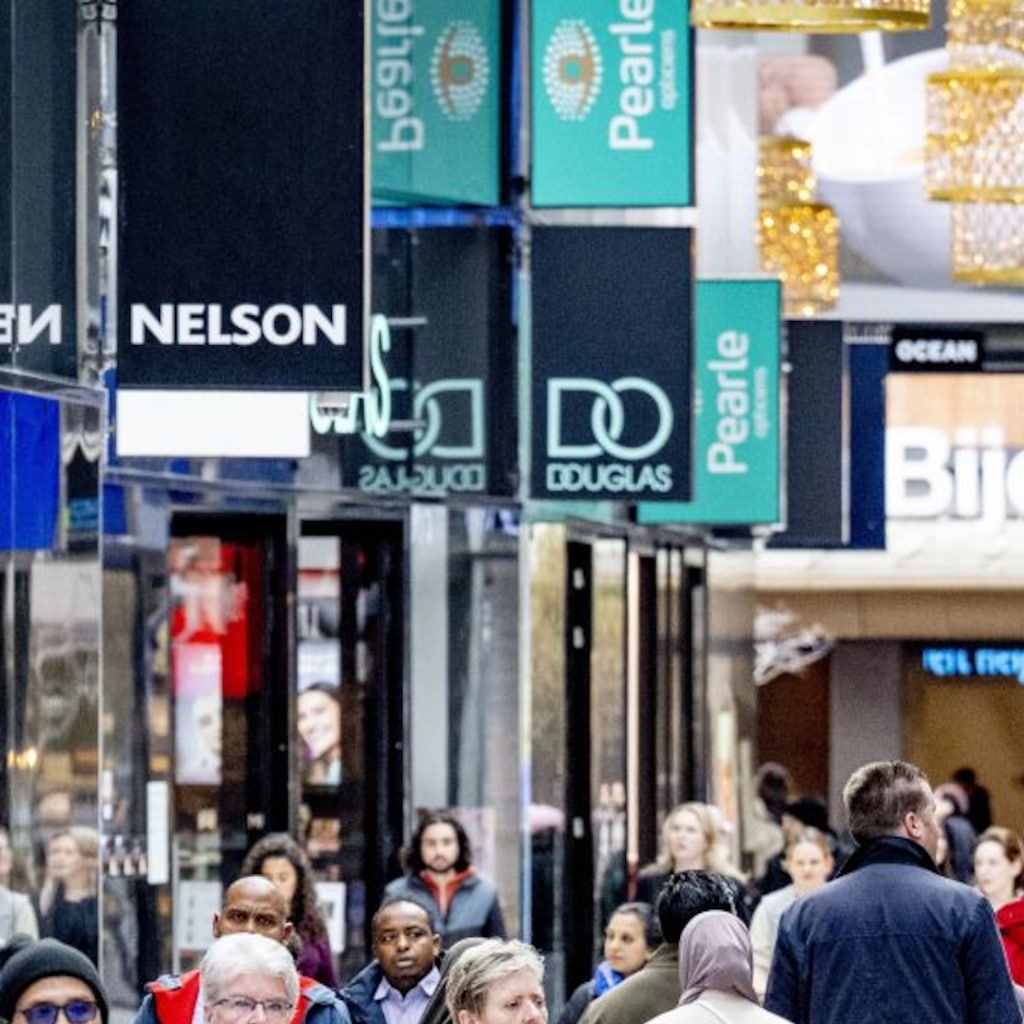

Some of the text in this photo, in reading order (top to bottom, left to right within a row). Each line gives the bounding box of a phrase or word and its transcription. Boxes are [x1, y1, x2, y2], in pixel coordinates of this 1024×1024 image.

[130, 303, 347, 346] NELSON
[895, 338, 978, 363] OCEAN
[707, 330, 749, 474] Pearle
[546, 463, 673, 492] DOUGLAS
